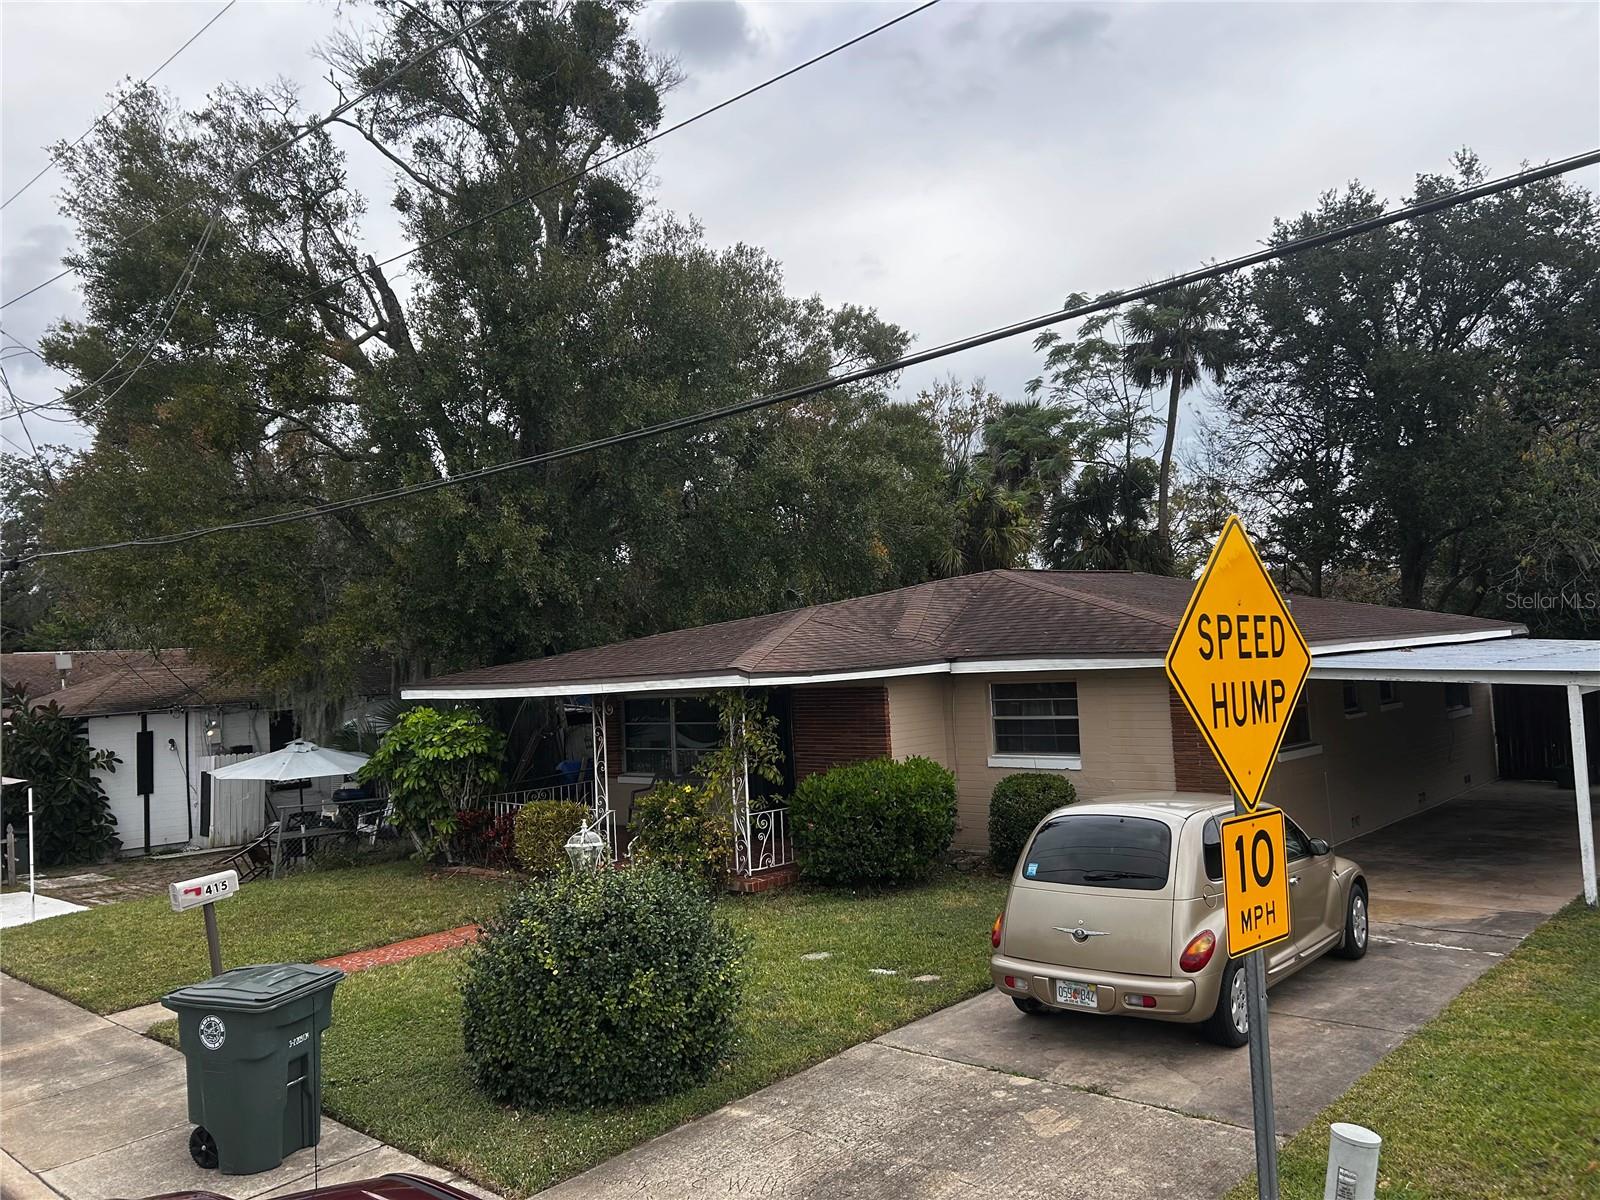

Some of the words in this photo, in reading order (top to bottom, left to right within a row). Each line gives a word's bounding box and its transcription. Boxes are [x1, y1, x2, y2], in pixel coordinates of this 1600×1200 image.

[1198, 613, 1286, 660] SPEED
[1211, 679, 1286, 729] HUMP
[1235, 829, 1274, 893] 10
[205, 880, 228, 895] 415
[1241, 900, 1276, 934] MPH
